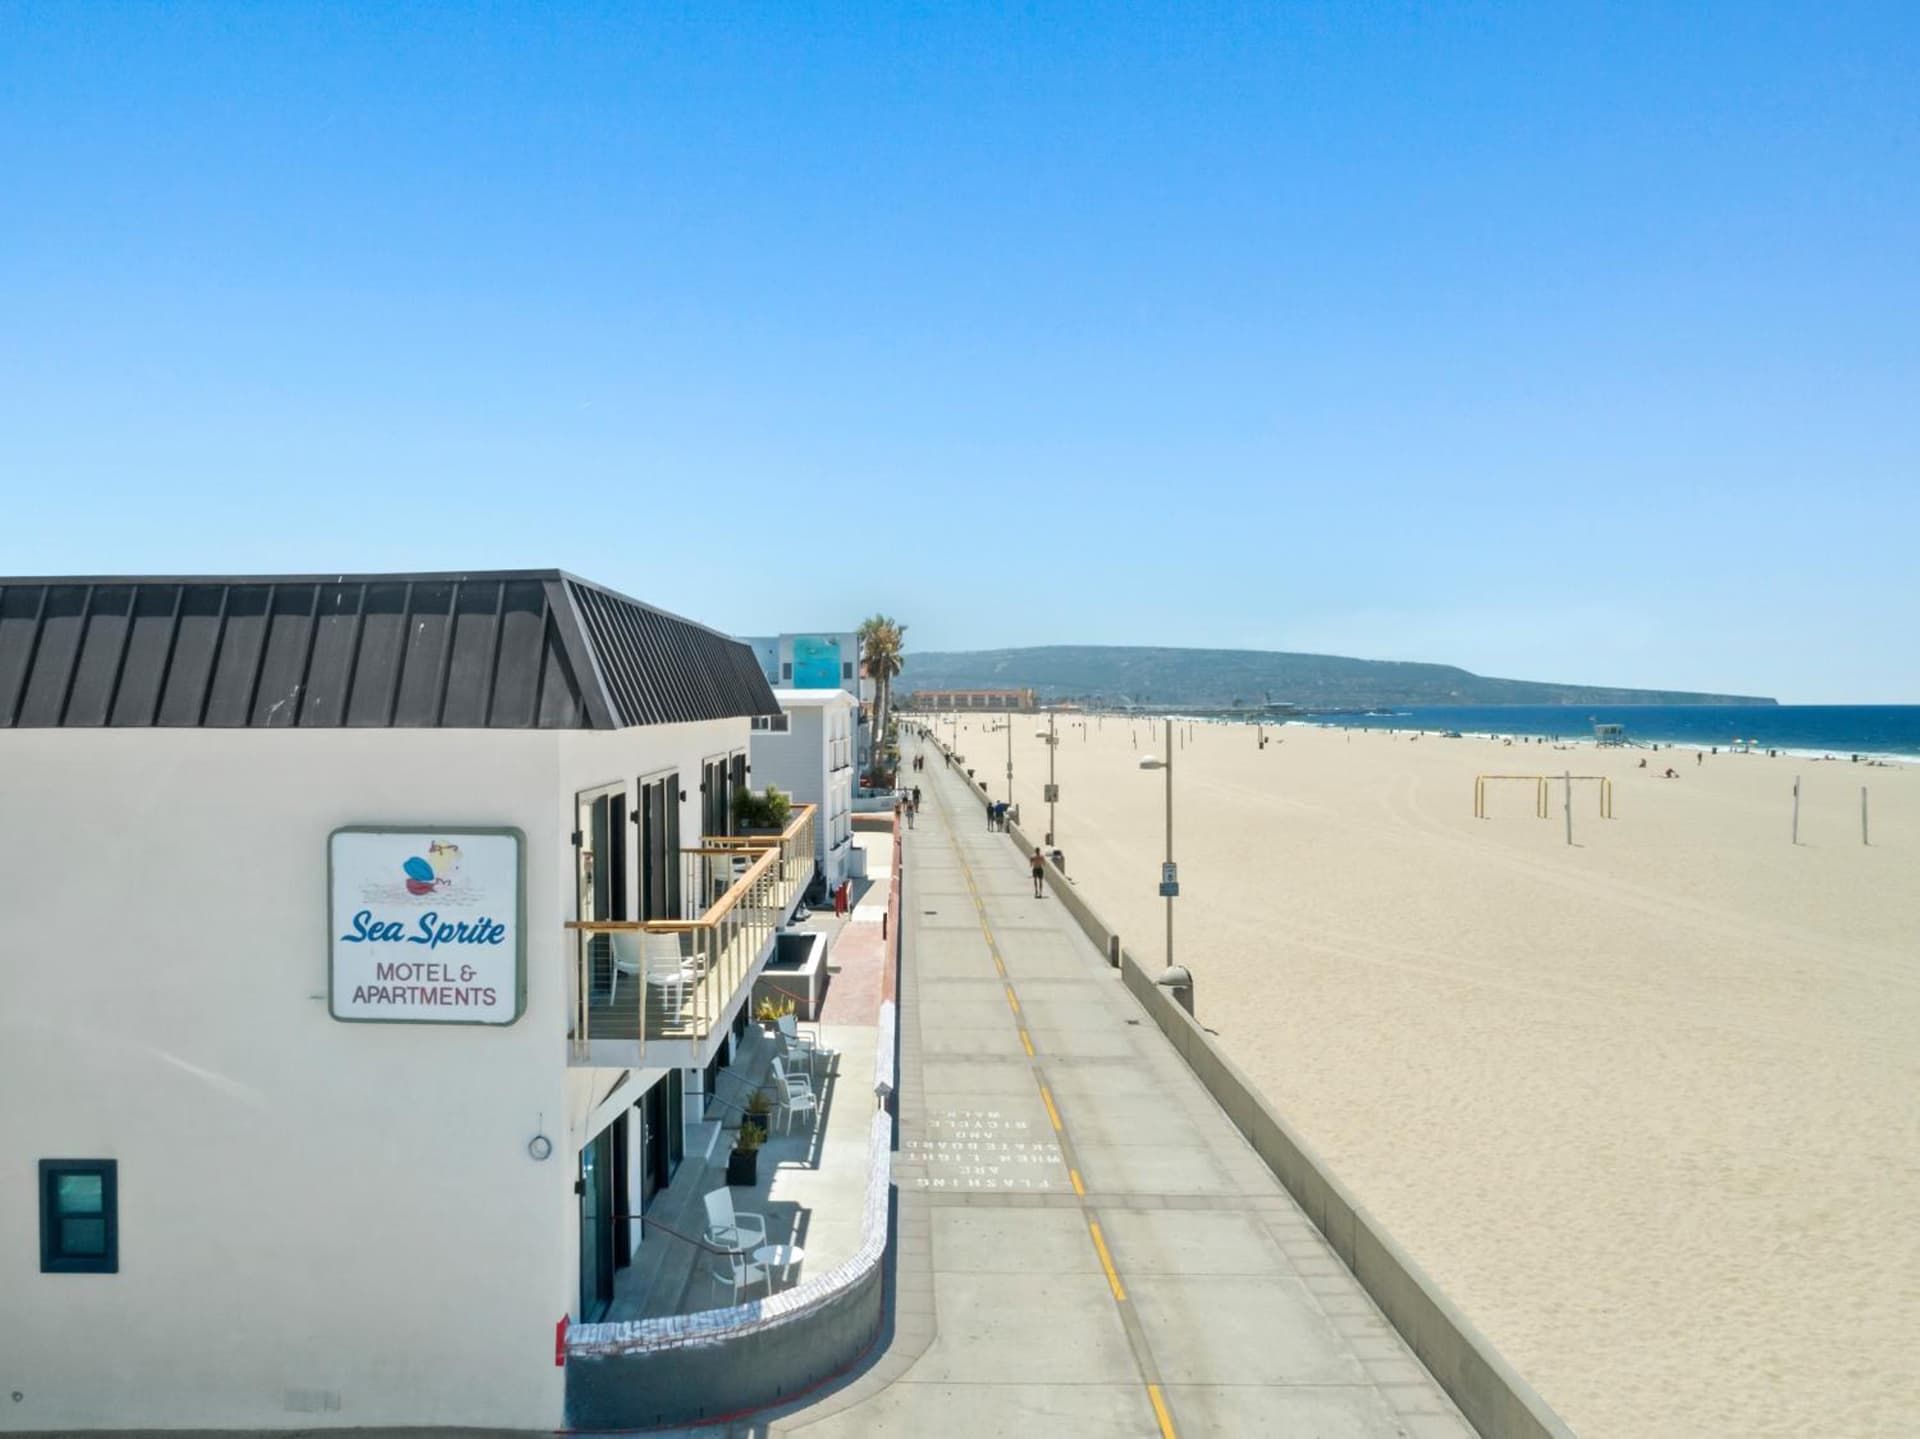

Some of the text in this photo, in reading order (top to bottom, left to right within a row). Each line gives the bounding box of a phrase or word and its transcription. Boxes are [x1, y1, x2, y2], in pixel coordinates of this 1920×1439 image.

[340, 910, 505, 950] Sea Sprite
[376, 962, 477, 982] MOTEL &
[352, 985, 497, 1006] APARTMENTS
[929, 1120, 1027, 1129] BICYCLE
[906, 1141, 1060, 1151] SKATEBOARD
[999, 1154, 1061, 1163] WHEN
[917, 1178, 1049, 1188] FLASHING
